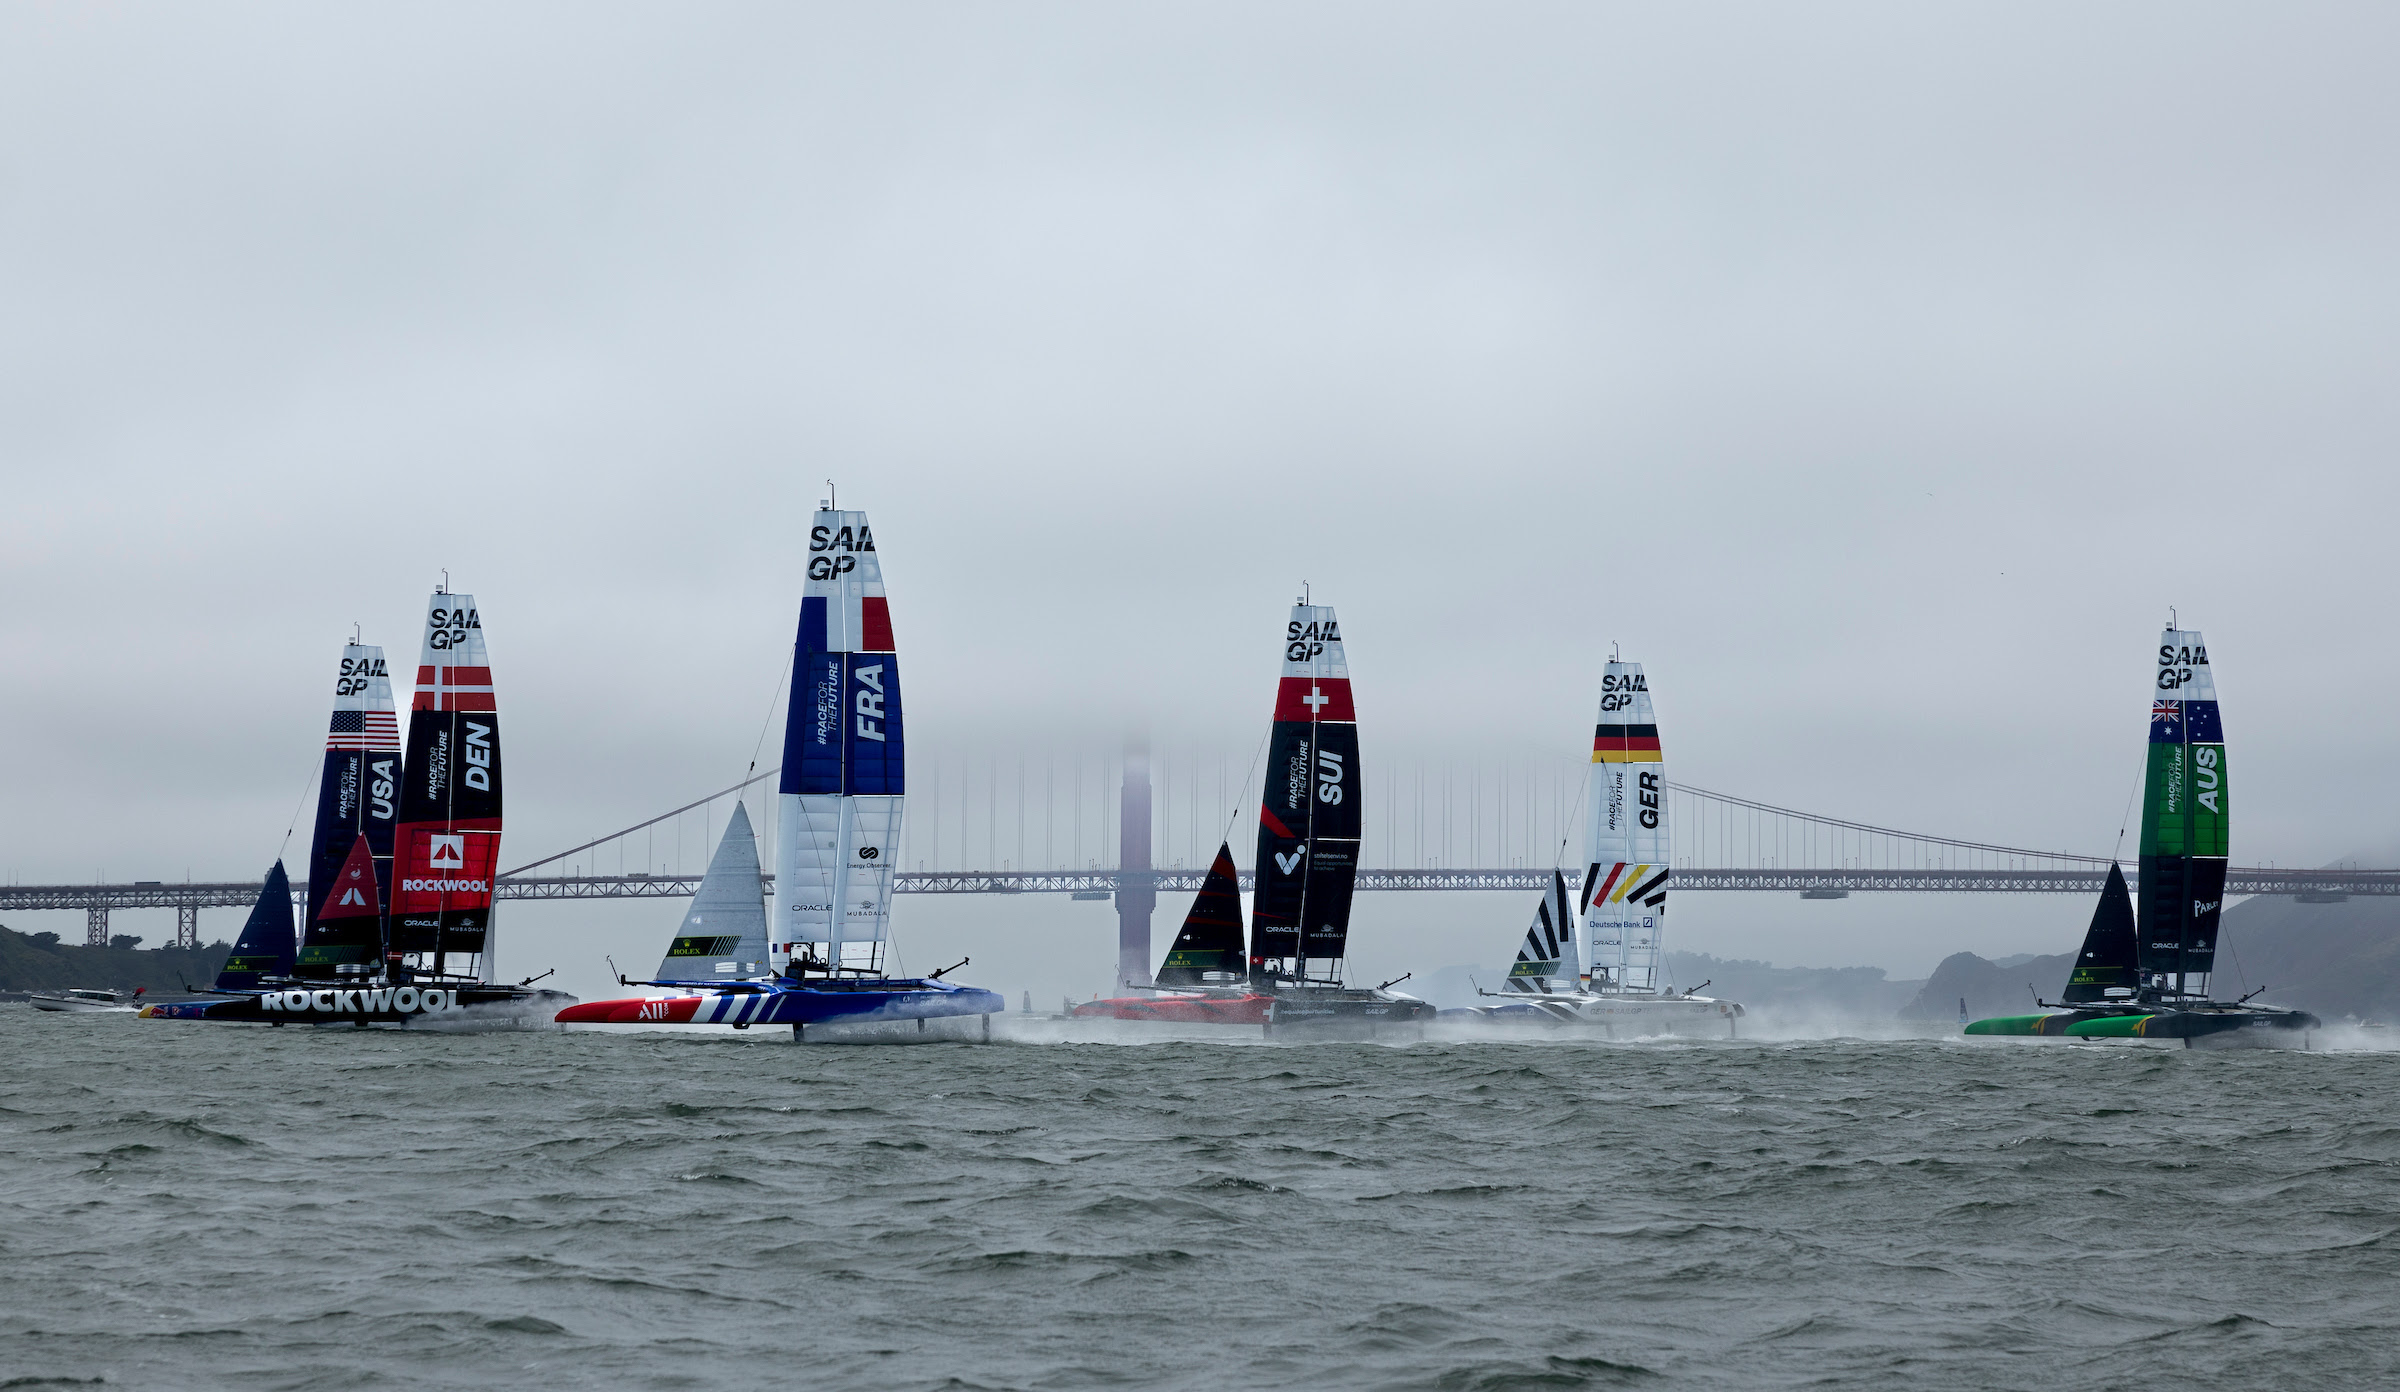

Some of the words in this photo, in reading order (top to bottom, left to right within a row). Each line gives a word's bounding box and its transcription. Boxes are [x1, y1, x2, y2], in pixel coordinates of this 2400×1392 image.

[809, 526, 876, 552] SAIL
[808, 555, 856, 581] GP
[429, 609, 481, 629] SAIL
[429, 630, 467, 650] GP
[1287, 621, 1341, 641] SAIL
[1287, 642, 1324, 662] GP
[2158, 645, 2209, 666] SAIL
[339, 658, 389, 677] SAIL
[336, 678, 368, 696] GP
[1601, 675, 1649, 692] SAIL
[2157, 668, 2192, 689] GP
[855, 663, 885, 742] FRA
[1601, 694, 1633, 711] GP
[465, 721, 491, 792] DEN
[1318, 750, 1343, 806] SUI
[2196, 747, 2219, 814] AUS
[371, 759, 394, 820] USA
[1639, 771, 1659, 829] GER
[402, 879, 488, 892] ROCKWOOL
[261, 987, 464, 1013] ROCKWOOL
